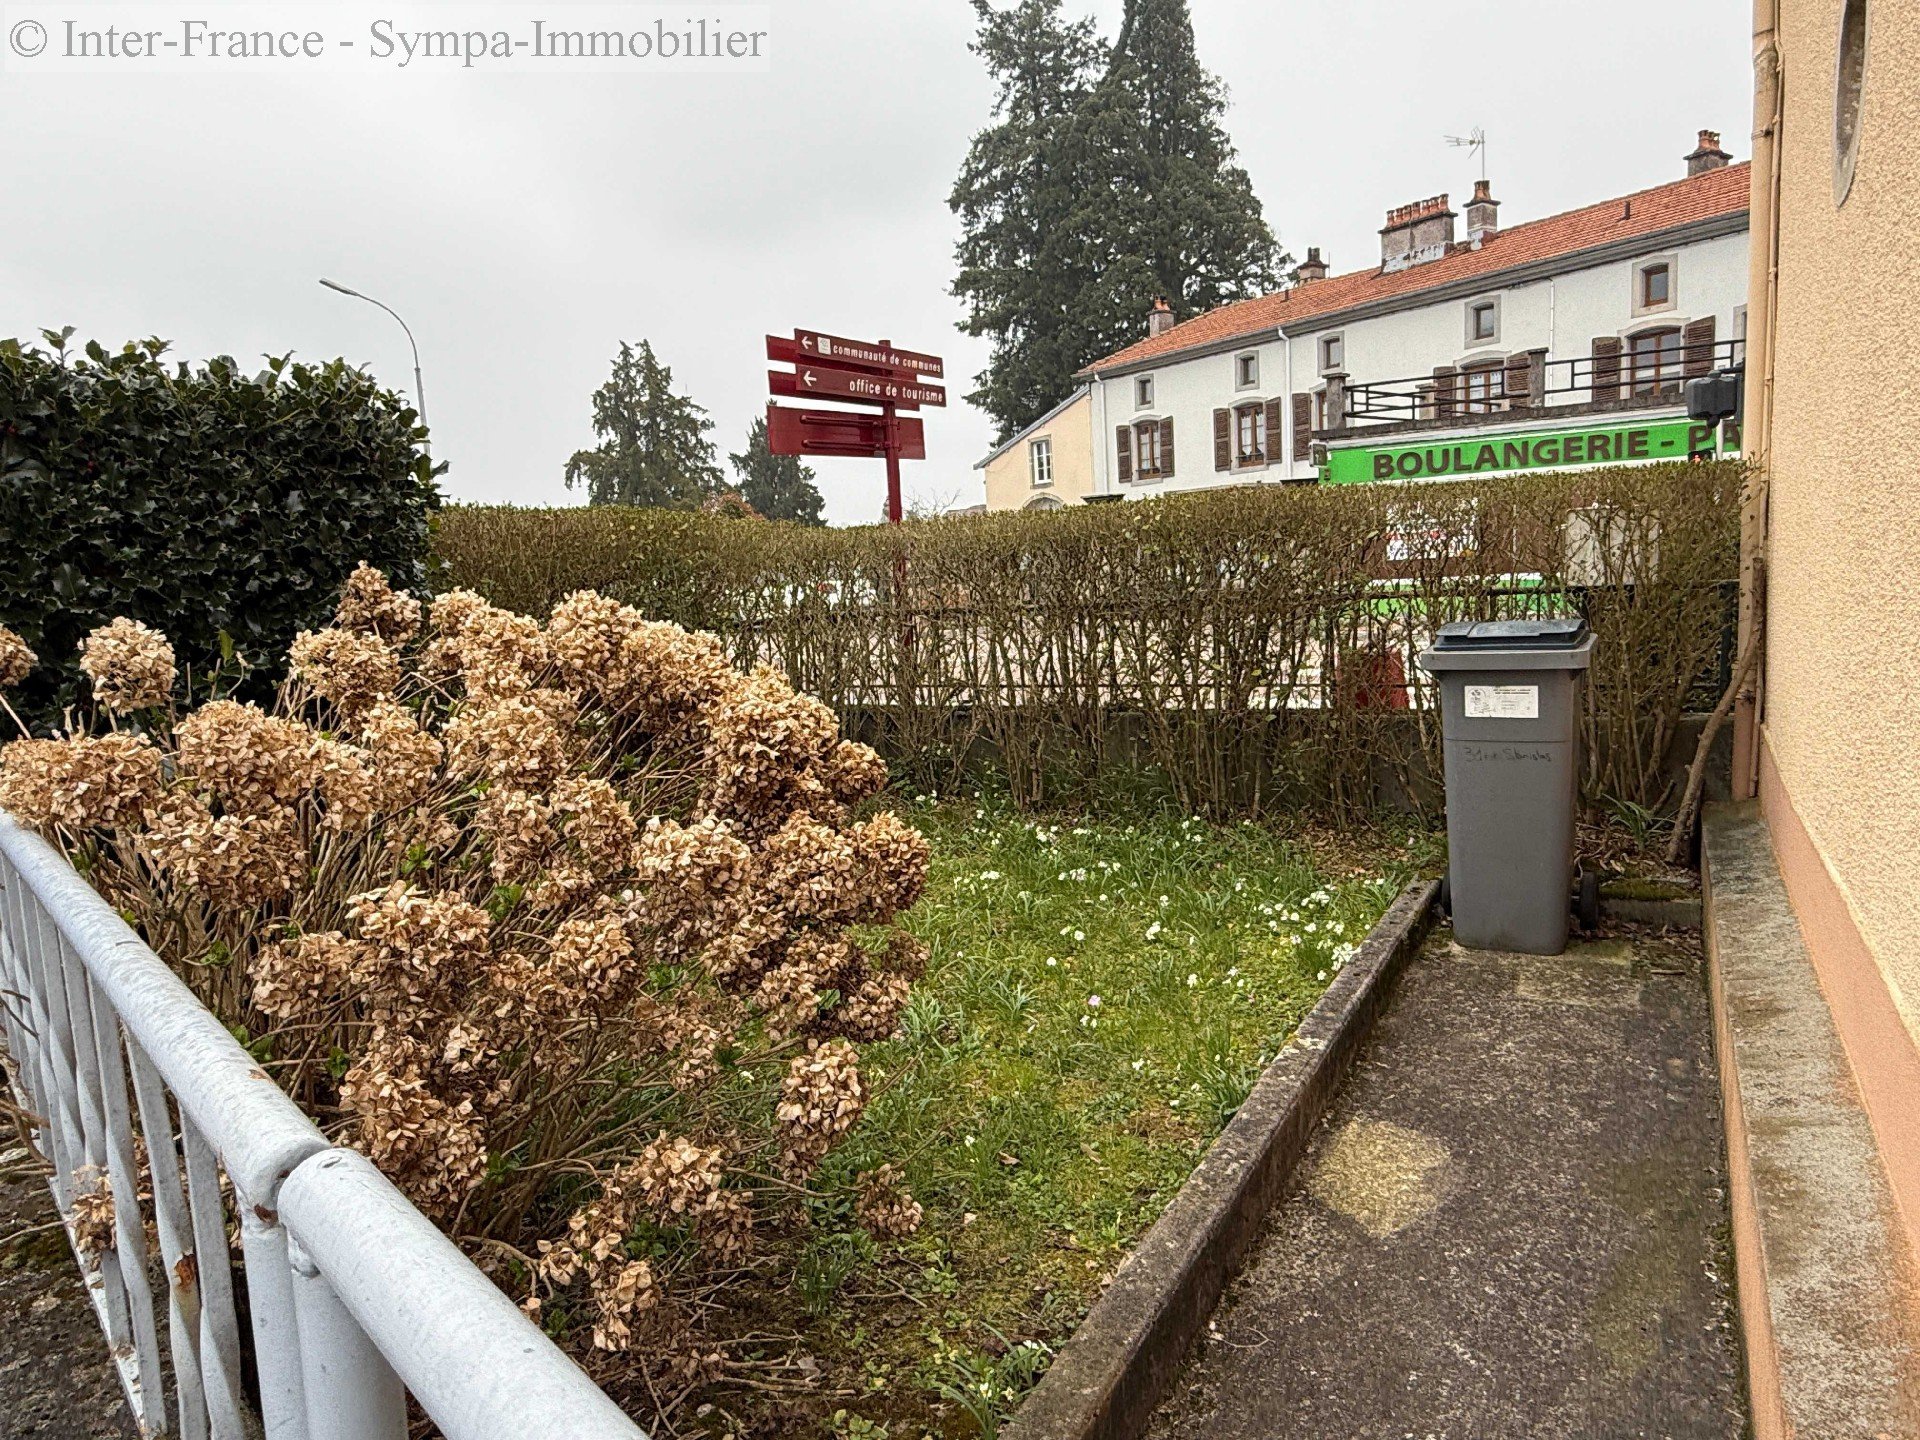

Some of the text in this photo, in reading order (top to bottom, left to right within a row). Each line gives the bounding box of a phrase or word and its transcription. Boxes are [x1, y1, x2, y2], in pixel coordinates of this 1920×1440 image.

[833, 344, 941, 373] communauté de communes
[849, 379, 943, 403] office de tourisme
[1374, 430, 1648, 478] BOULANGERIE
